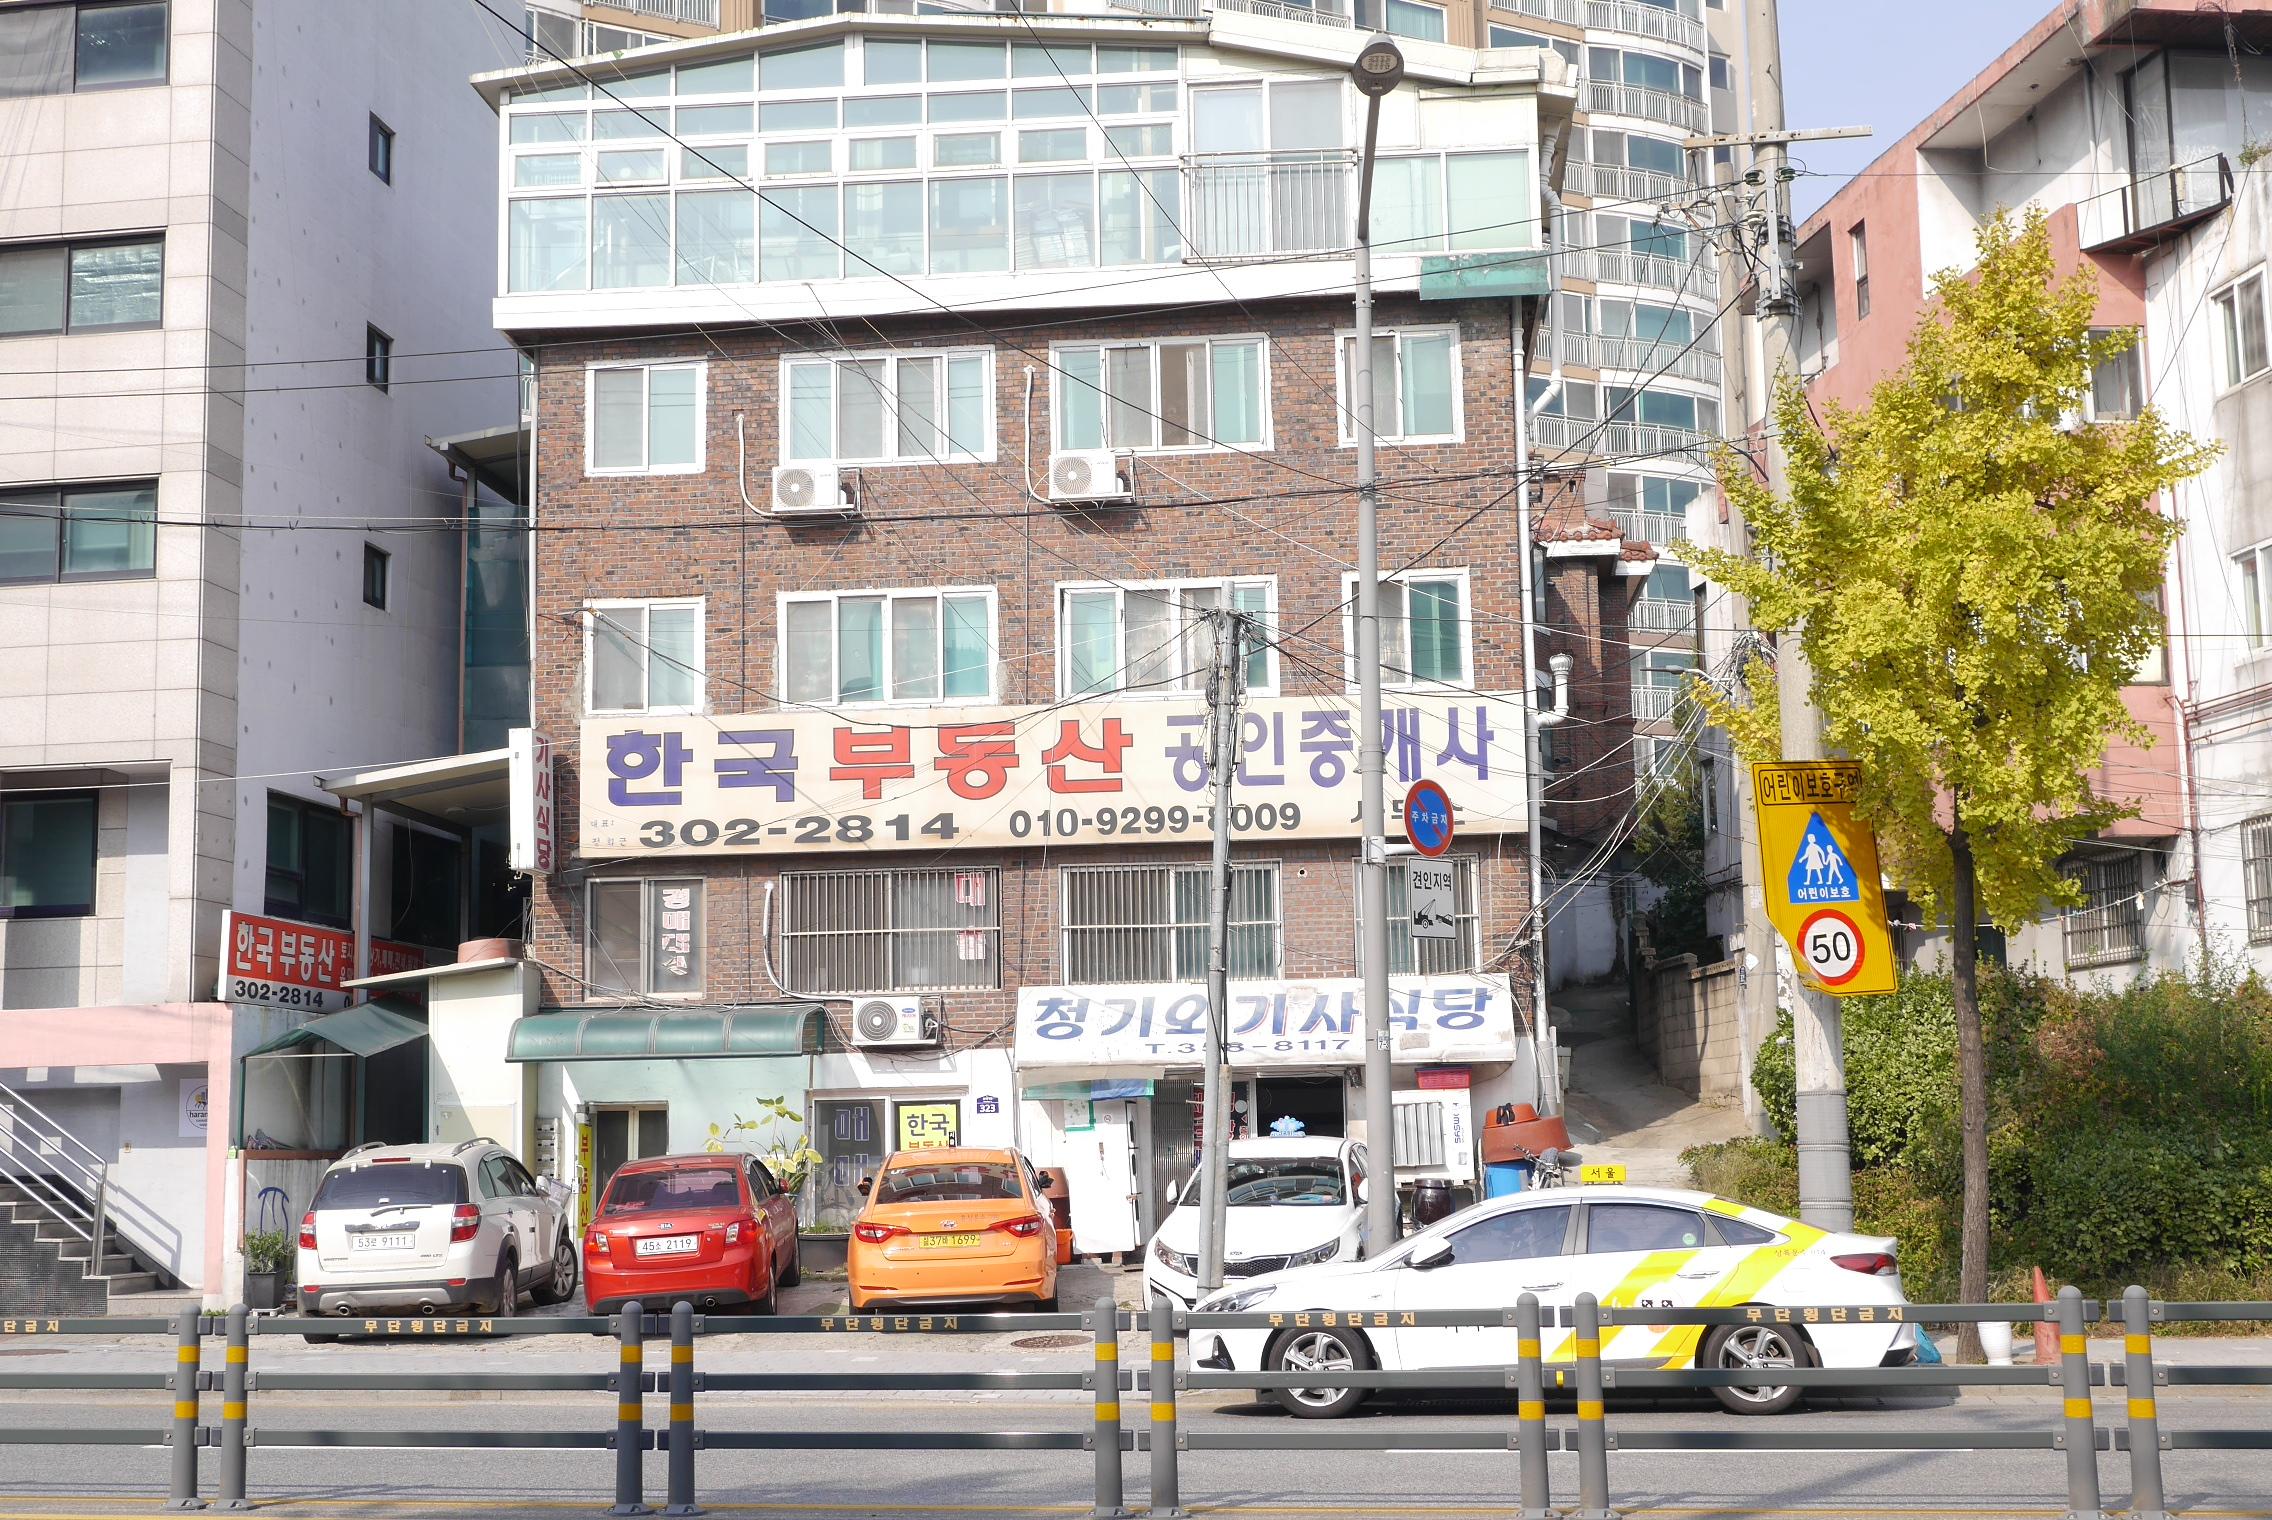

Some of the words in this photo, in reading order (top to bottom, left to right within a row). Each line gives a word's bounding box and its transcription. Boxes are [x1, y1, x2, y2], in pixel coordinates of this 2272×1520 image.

[606, 729, 798, 807] 한국
[829, 717, 1134, 801] 부동산
[1164, 706, 1495, 793] 공인중개사
[536, 736, 551, 870] 기사식당
[1412, 811, 1448, 825] 주차금지
[639, 813, 960, 849] 302-2814
[1412, 871, 1452, 891] 견인지역
[1798, 886, 1851, 900] 어린이보호
[236, 921, 275, 974] 한국
[279, 929, 335, 983] 부동산
[1812, 931, 1851, 964] 50
[234, 979, 324, 1008] 302-2814
[1234, 987, 1494, 1037] 기사식당
[1145, 1039, 1350, 1054] T.38-8117
[980, 1104, 996, 1113] 323
[907, 1113, 951, 1137] 한국
[1590, 1167, 1616, 1179] 서울
[580, 1136, 589, 1228] 부동산
[382, 1235, 406, 1247] 9111
[666, 1239, 692, 1250] 2119
[952, 1234, 976, 1245] 1699
[1268, 1311, 1416, 1328] 무단횡단금지
[1746, 1306, 1904, 1323] 무단횡단금지
[3, 1319, 59, 1333] 단금지
[364, 1319, 492, 1333] 무단횡단금지
[820, 1317, 958, 1331] 무단횡단금지
